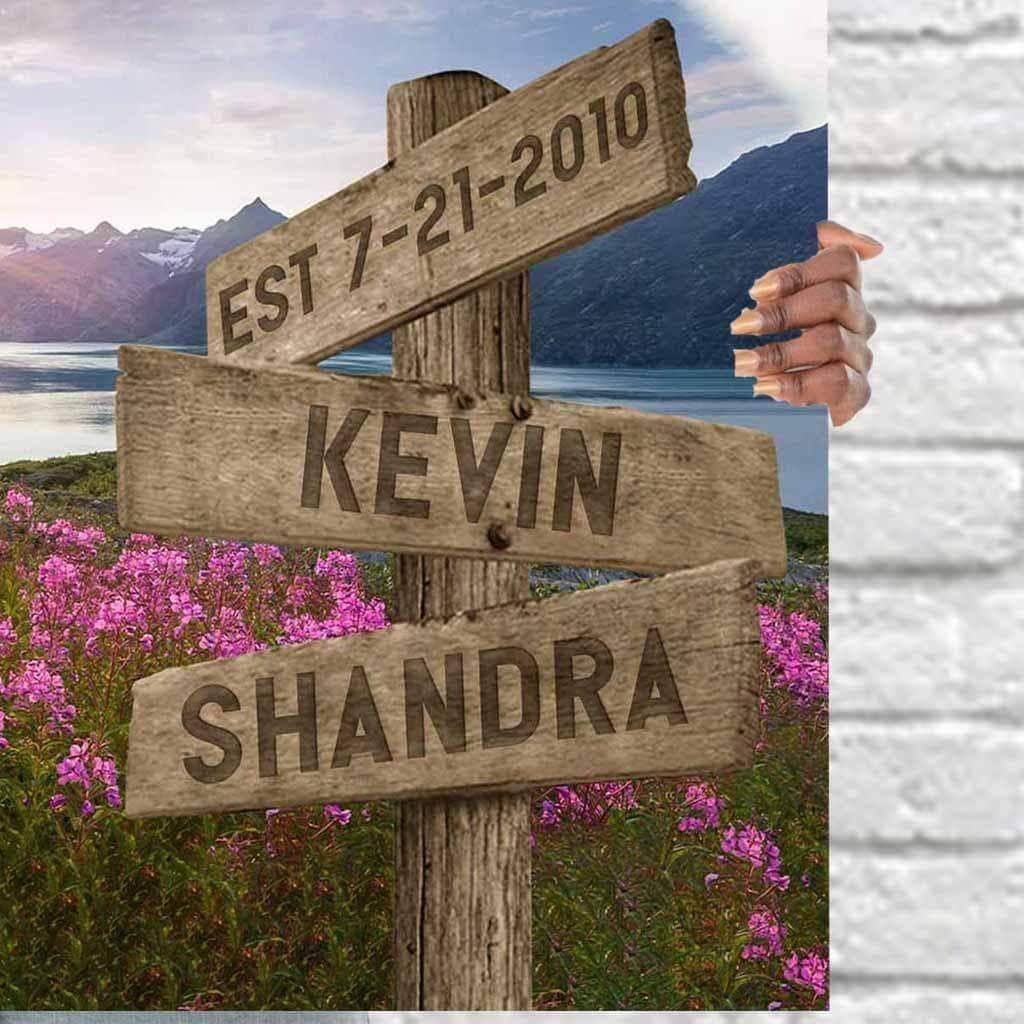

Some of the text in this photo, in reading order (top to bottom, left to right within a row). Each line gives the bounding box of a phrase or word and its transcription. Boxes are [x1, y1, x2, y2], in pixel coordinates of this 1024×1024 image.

[219, 81, 648, 355] EST 7-21-2010
[301, 405, 622, 536] KEVIN
[181, 627, 688, 784] SHANDRA
